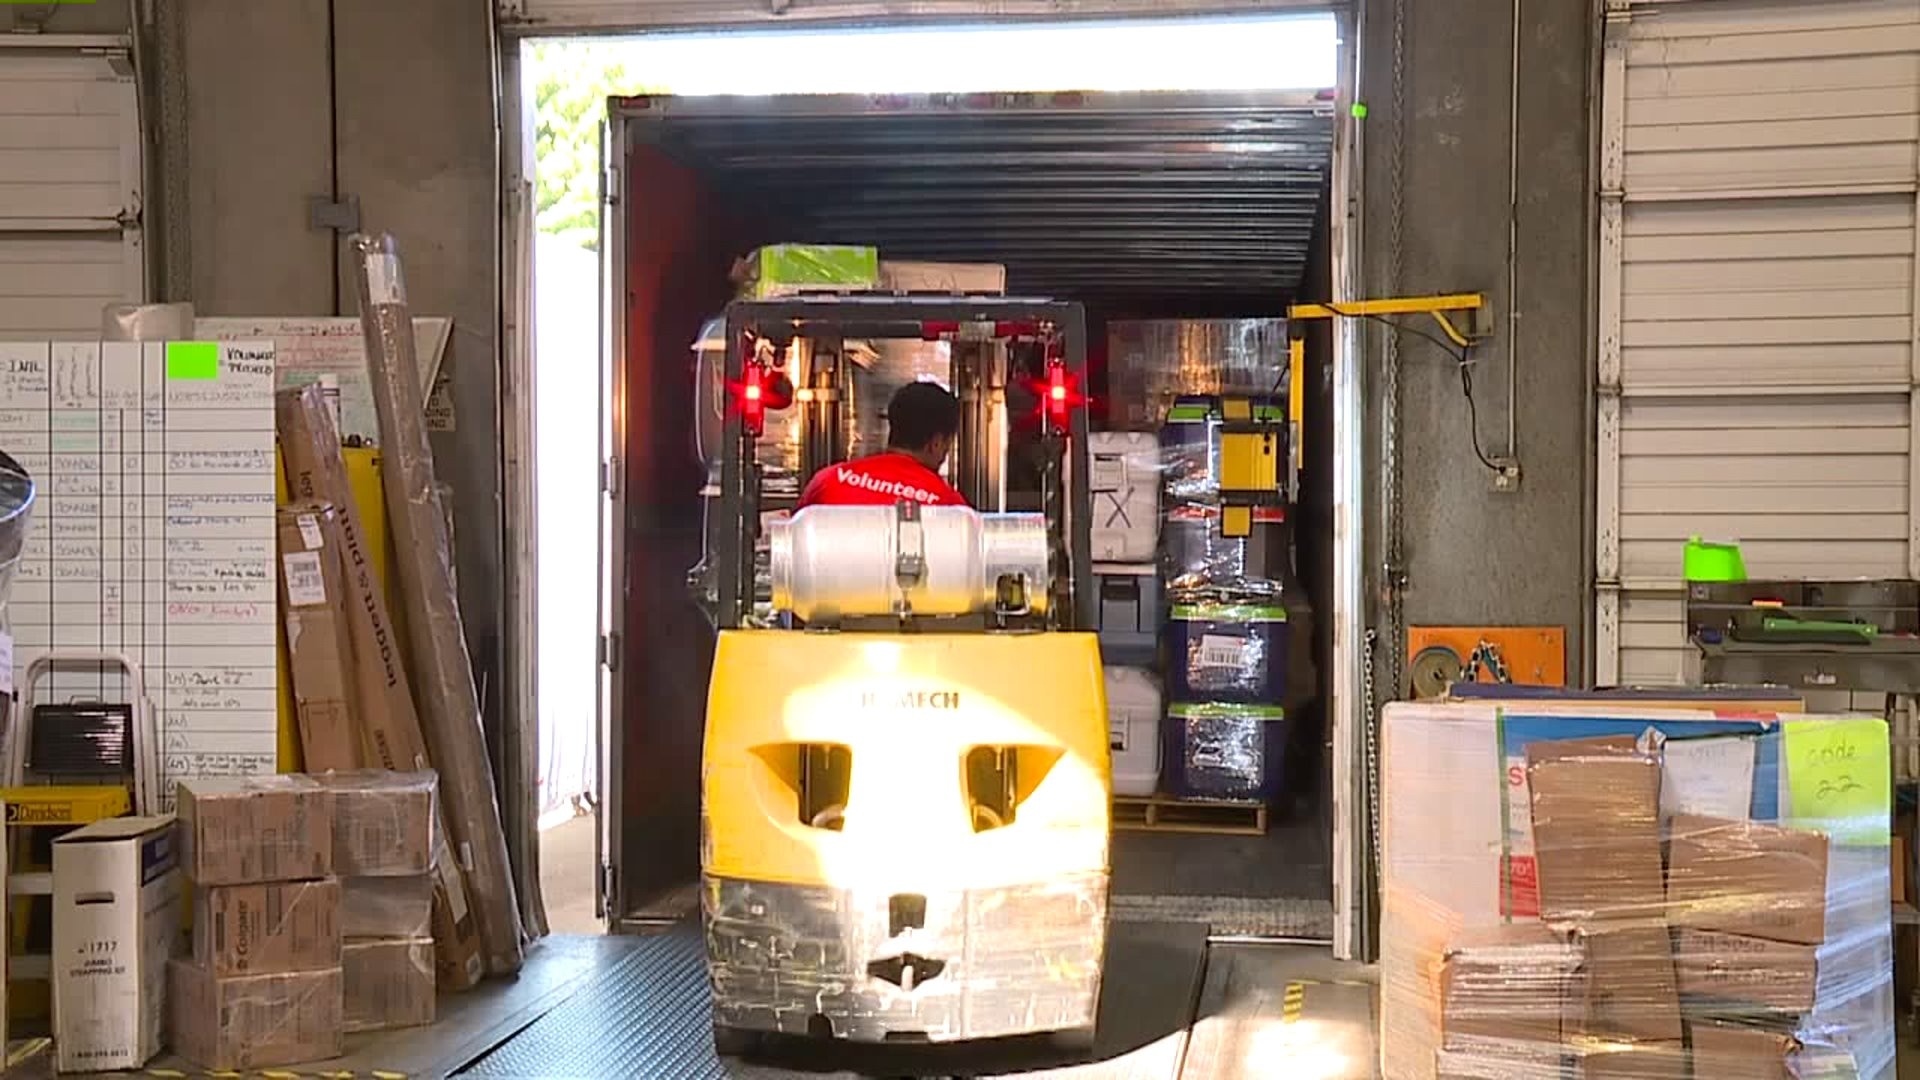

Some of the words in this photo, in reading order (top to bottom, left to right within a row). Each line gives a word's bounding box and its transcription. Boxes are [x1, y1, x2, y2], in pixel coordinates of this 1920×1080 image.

[837, 467, 940, 504] Volunteer
[364, 592, 397, 688] leggett
[1806, 731, 1858, 767] code
[1815, 774, 1866, 801] 22
[237, 900, 249, 956] Colgate
